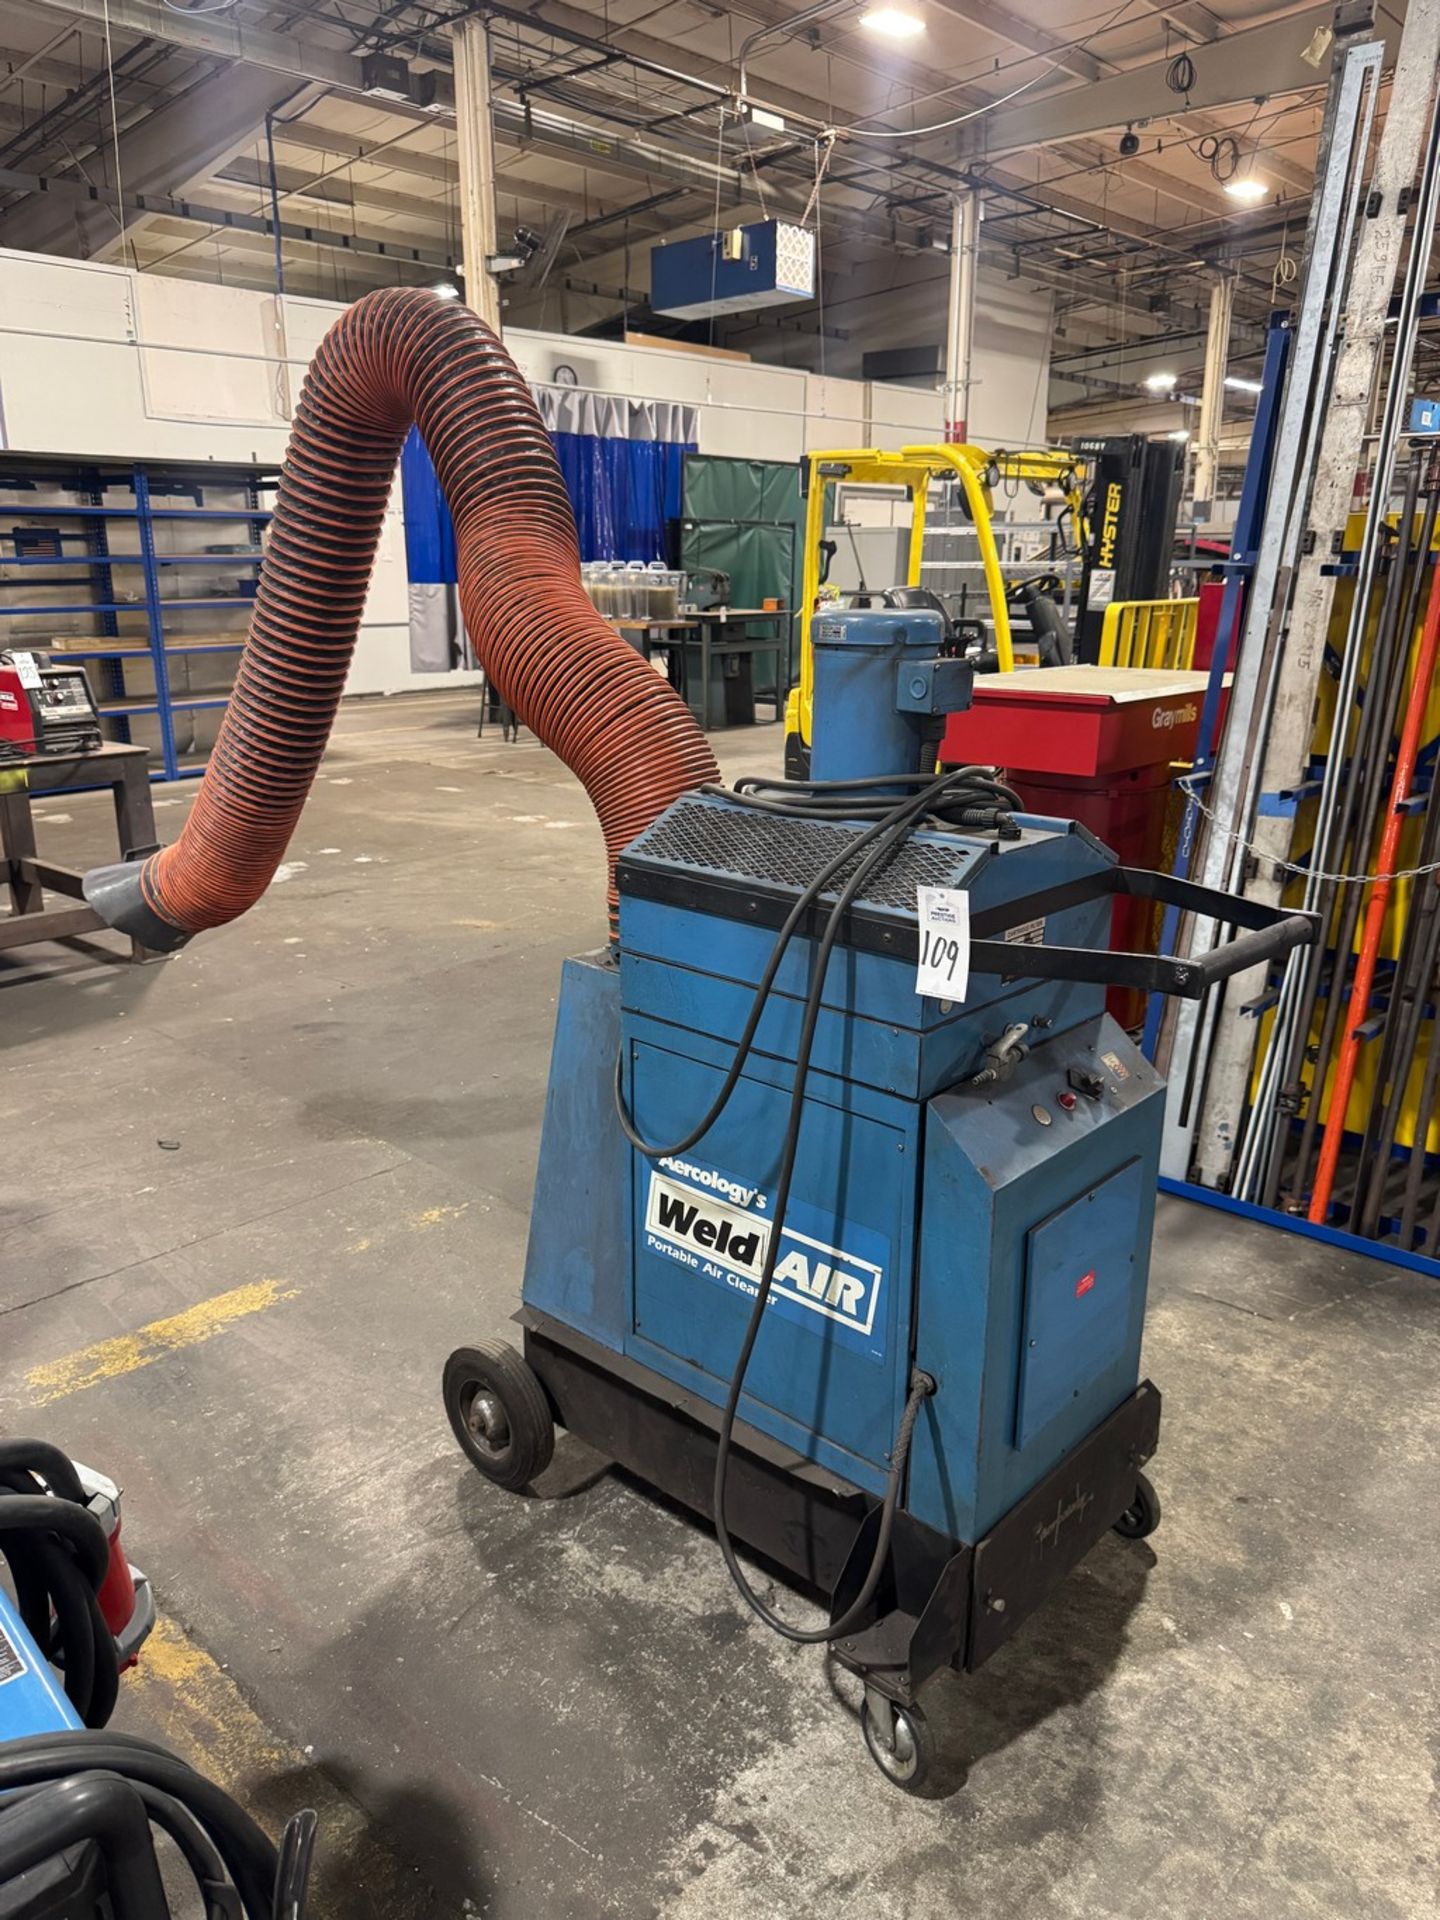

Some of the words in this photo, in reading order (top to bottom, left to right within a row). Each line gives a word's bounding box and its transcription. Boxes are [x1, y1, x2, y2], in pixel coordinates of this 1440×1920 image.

[1098, 482, 1122, 568] HYSTER
[1152, 704, 1197, 730] Graymills
[921, 930, 959, 981] 109
[647, 1233, 699, 1268] Portable
[702, 1260, 723, 1280] Air
[658, 1192, 761, 1267] Weld
[772, 1249, 866, 1316] AIR
